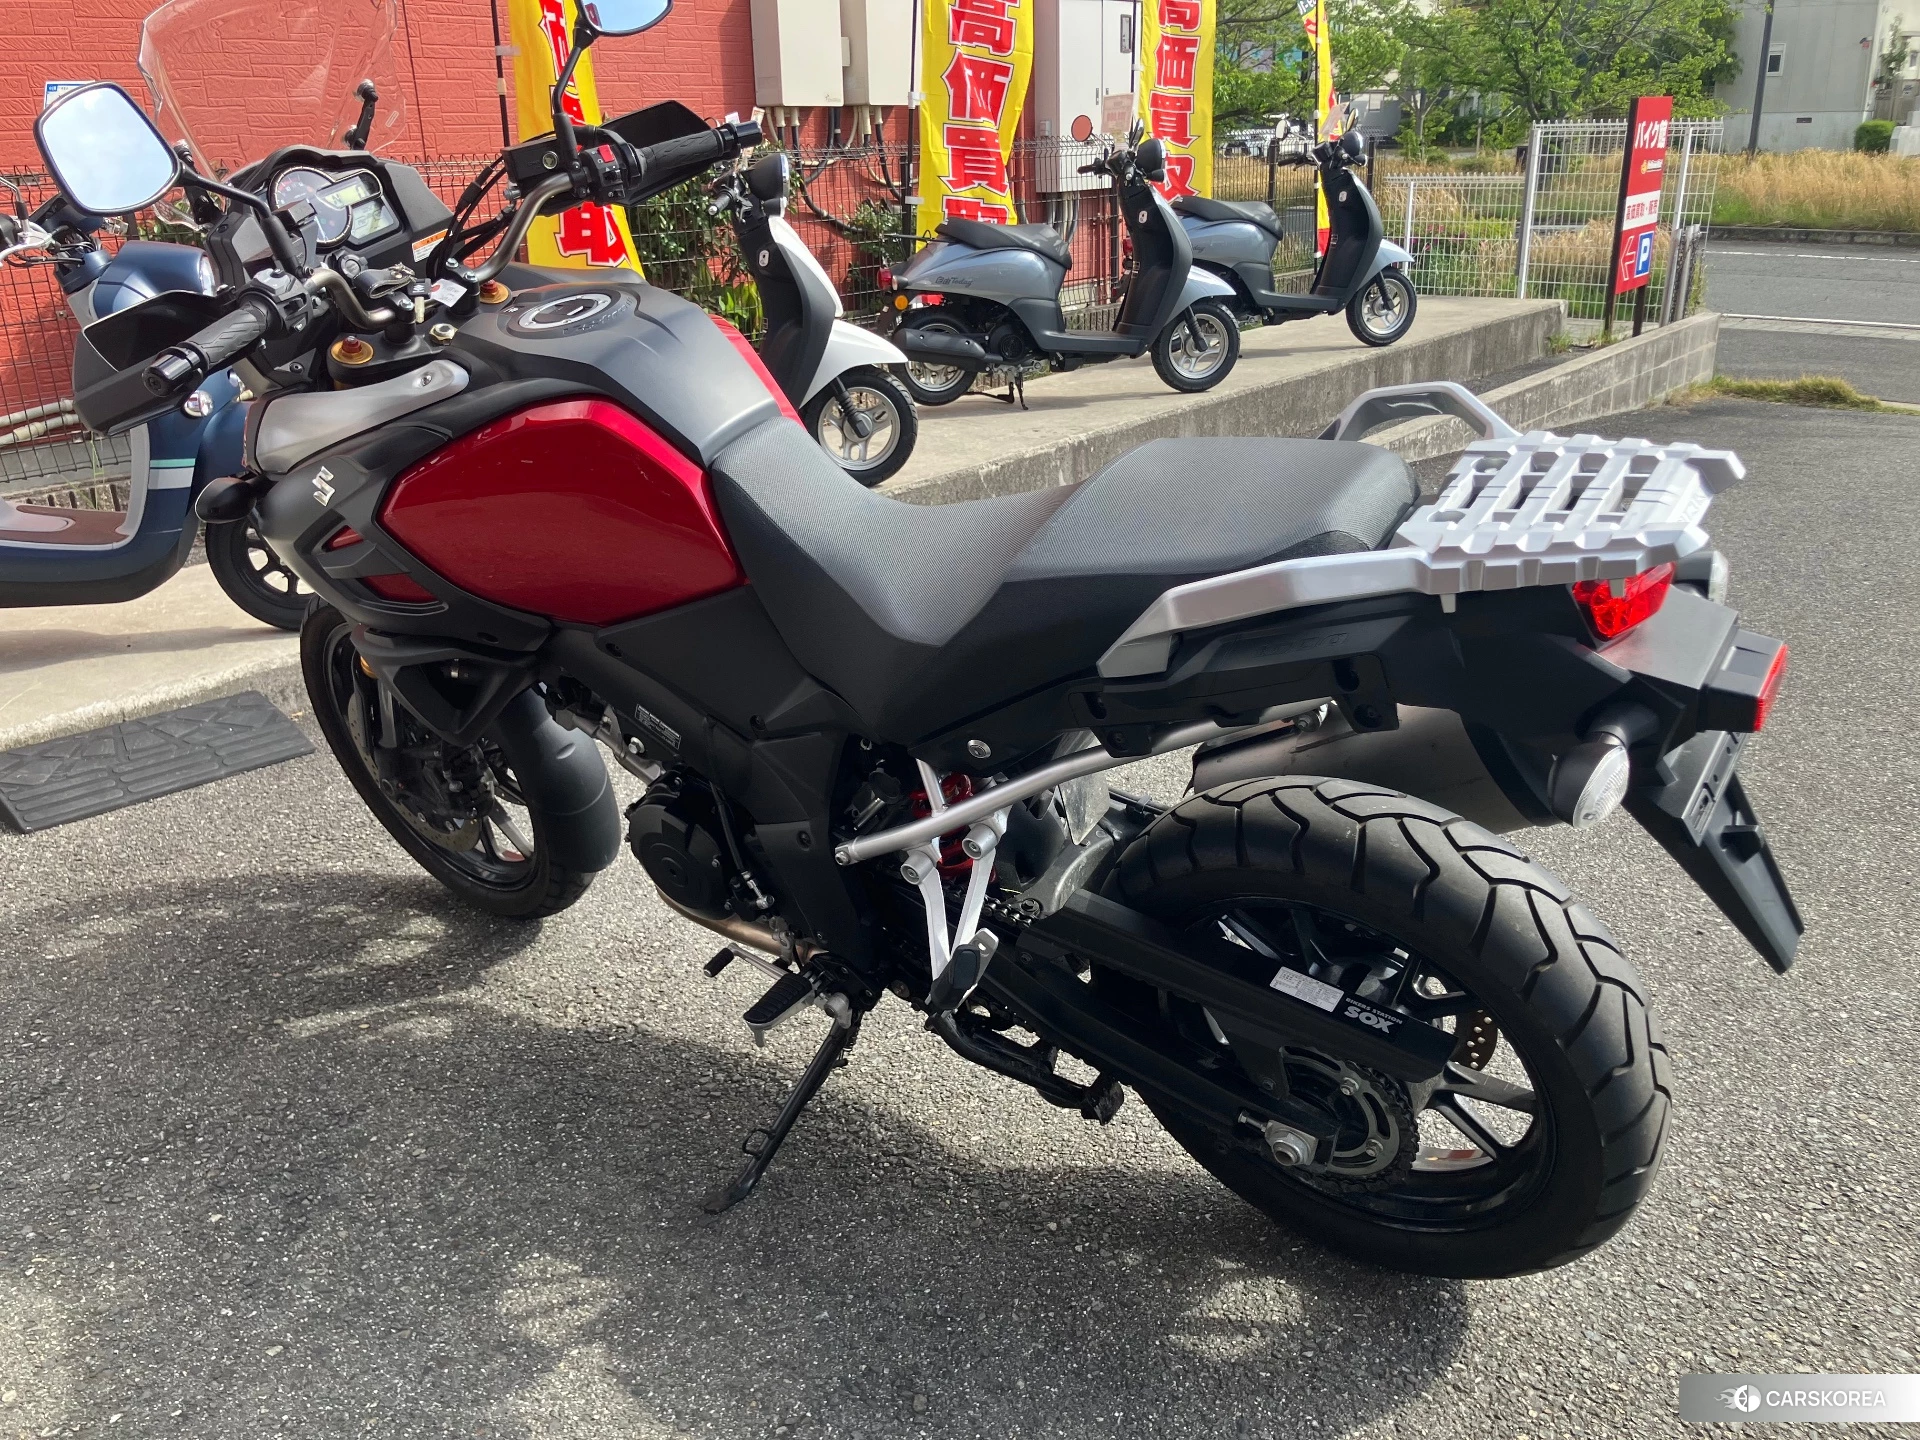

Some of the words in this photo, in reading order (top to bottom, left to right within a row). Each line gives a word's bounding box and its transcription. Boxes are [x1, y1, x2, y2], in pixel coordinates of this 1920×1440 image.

[1638, 237, 1651, 271] P
[1343, 1005, 1395, 1034] SOX
[1345, 997, 1371, 1011] BIKERS
[1371, 1008, 1403, 1025] STATION
